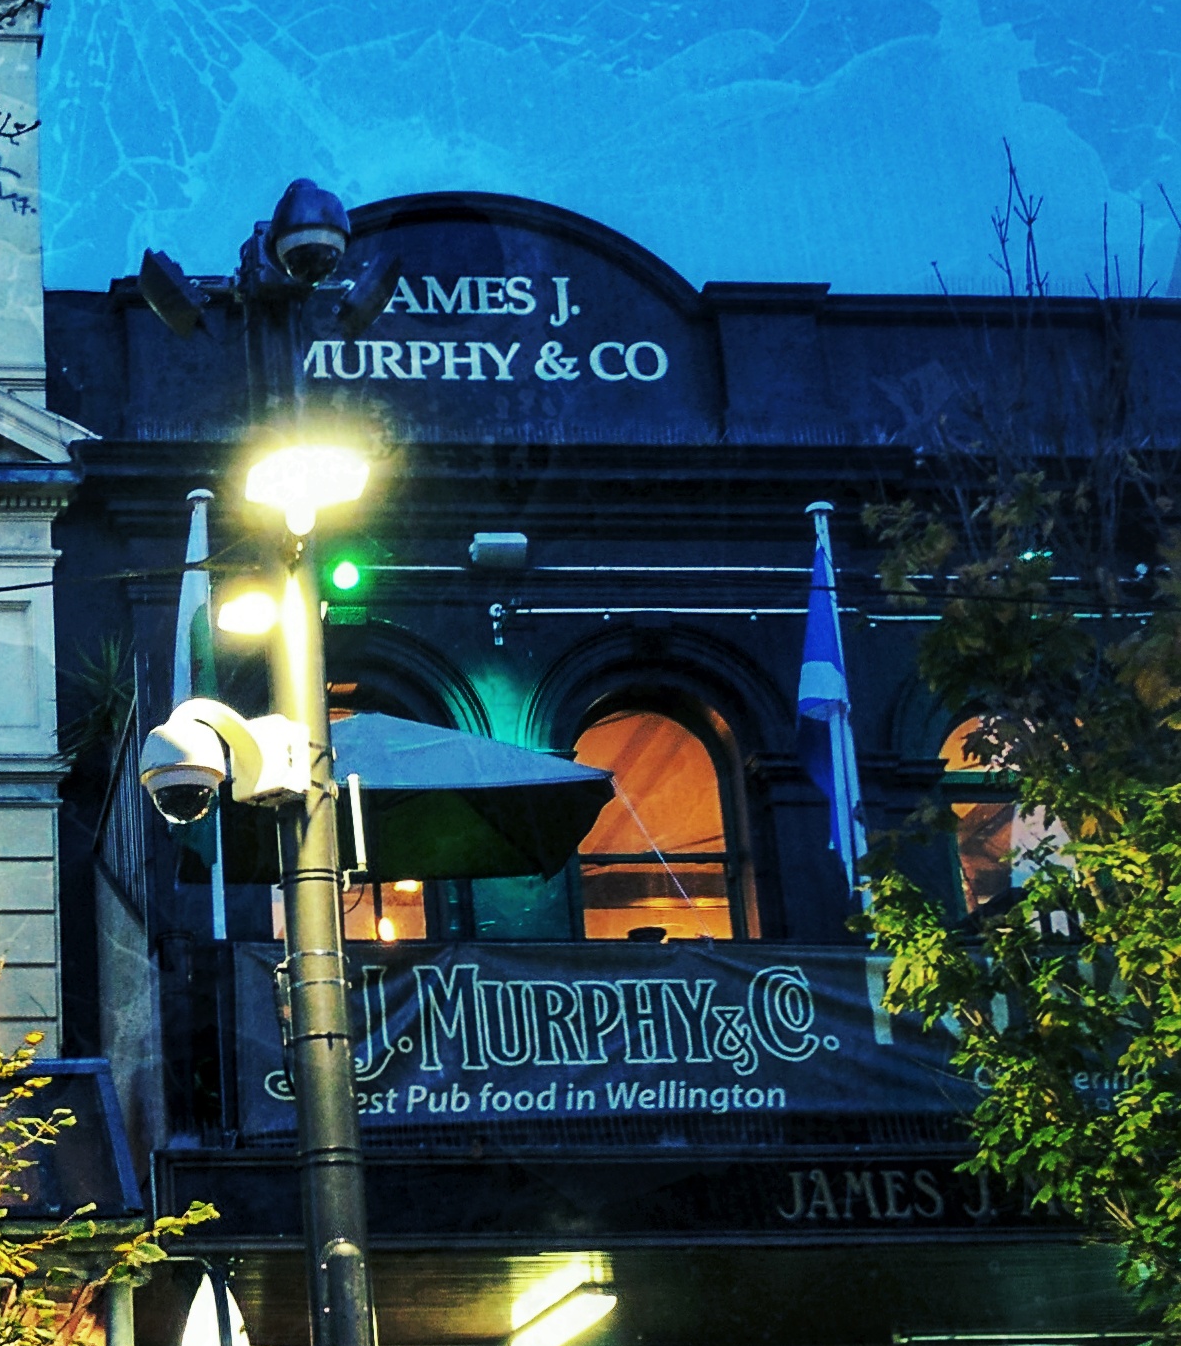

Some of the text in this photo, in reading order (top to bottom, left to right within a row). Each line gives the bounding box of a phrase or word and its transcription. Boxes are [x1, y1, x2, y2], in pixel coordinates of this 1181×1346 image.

[382, 275, 582, 328] AMES J.
[533, 339, 582, 382] &
[588, 340, 670, 382] CO
[356, 1080, 787, 1115] est Pub food in Wellington
[777, 1167, 946, 1221] JAMES
